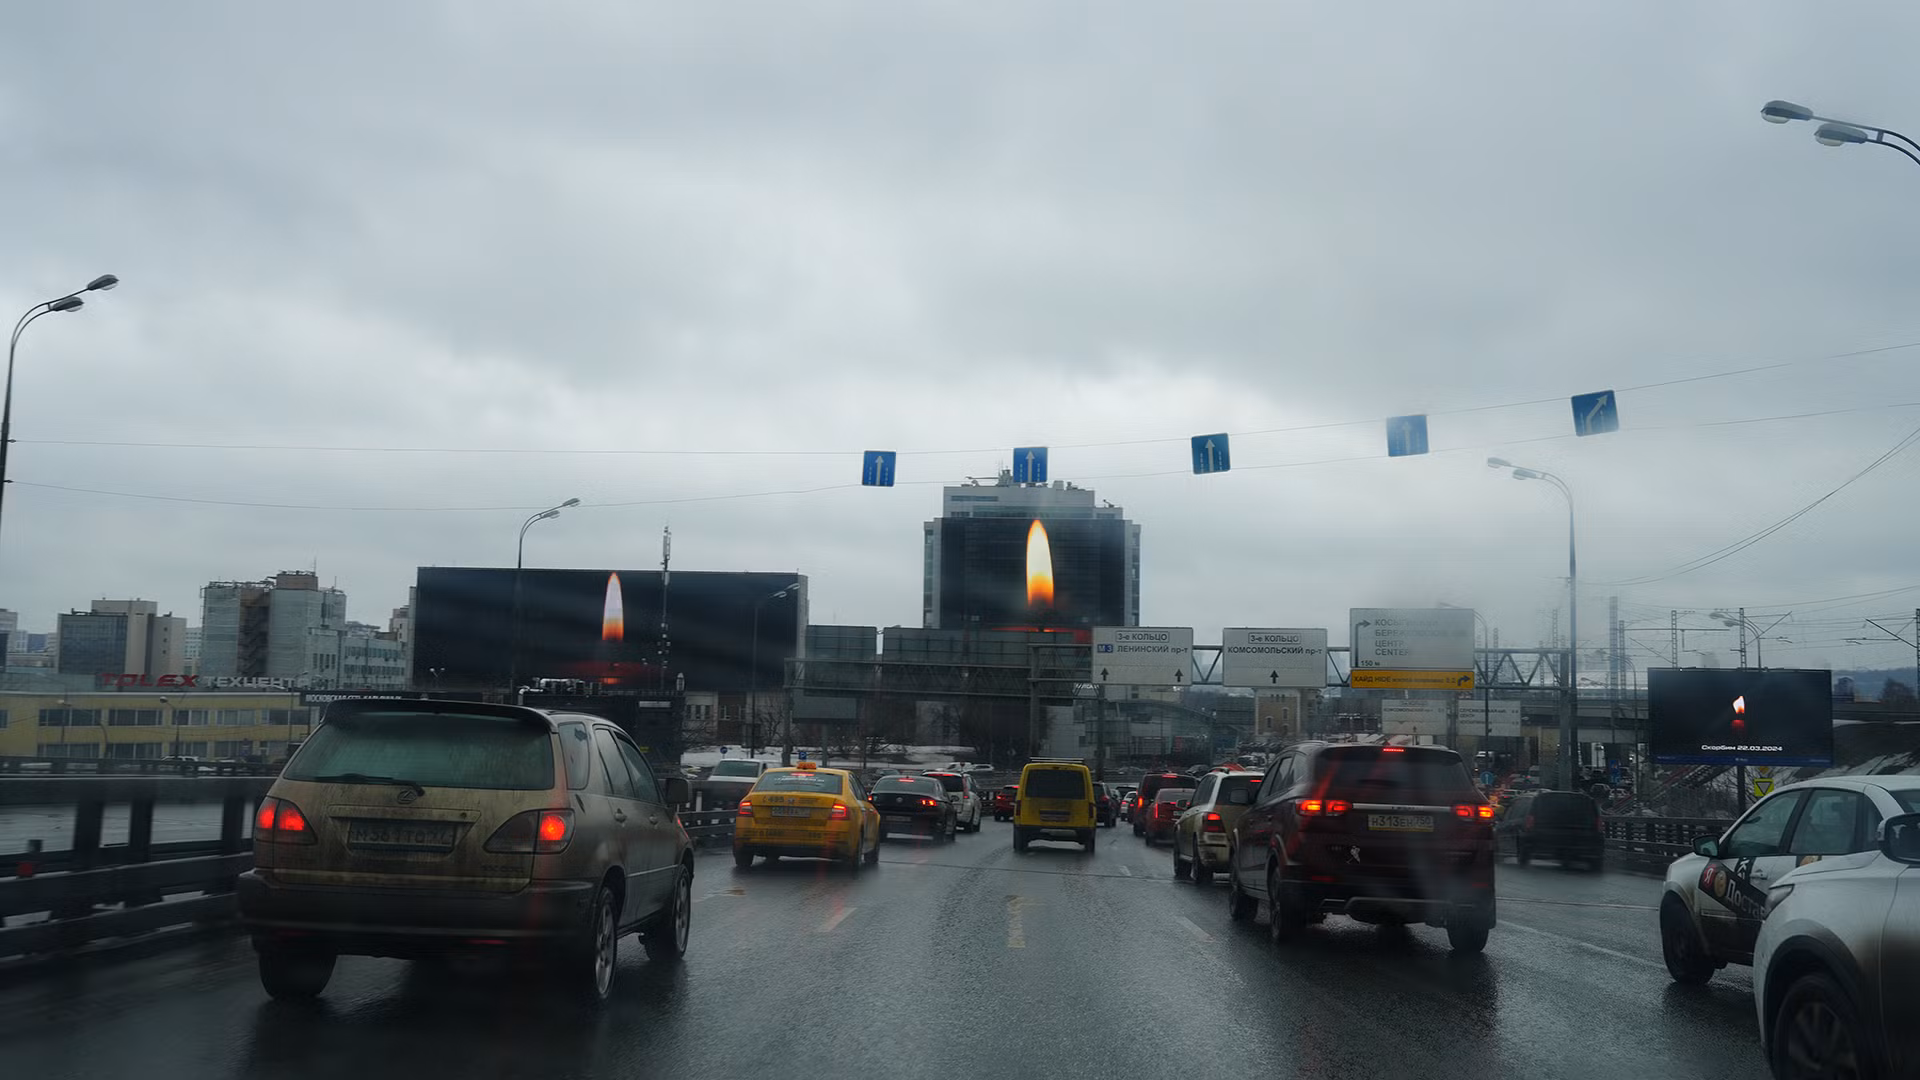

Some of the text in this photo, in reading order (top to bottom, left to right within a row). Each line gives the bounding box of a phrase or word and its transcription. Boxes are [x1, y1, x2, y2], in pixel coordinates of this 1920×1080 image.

[1118, 633, 1168, 642] 3-е КОЛЬЦО
[1250, 635, 1300, 643] 3-е КОЛЬЦО
[1117, 645, 1169, 653] ЛЕНИНСКИЙ
[1375, 640, 1404, 649] ЦЕНТР
[1227, 646, 1322, 656] КОМСОМОЛЬСКИЙ пр-т
[99, 673, 199, 688] TOLEX
